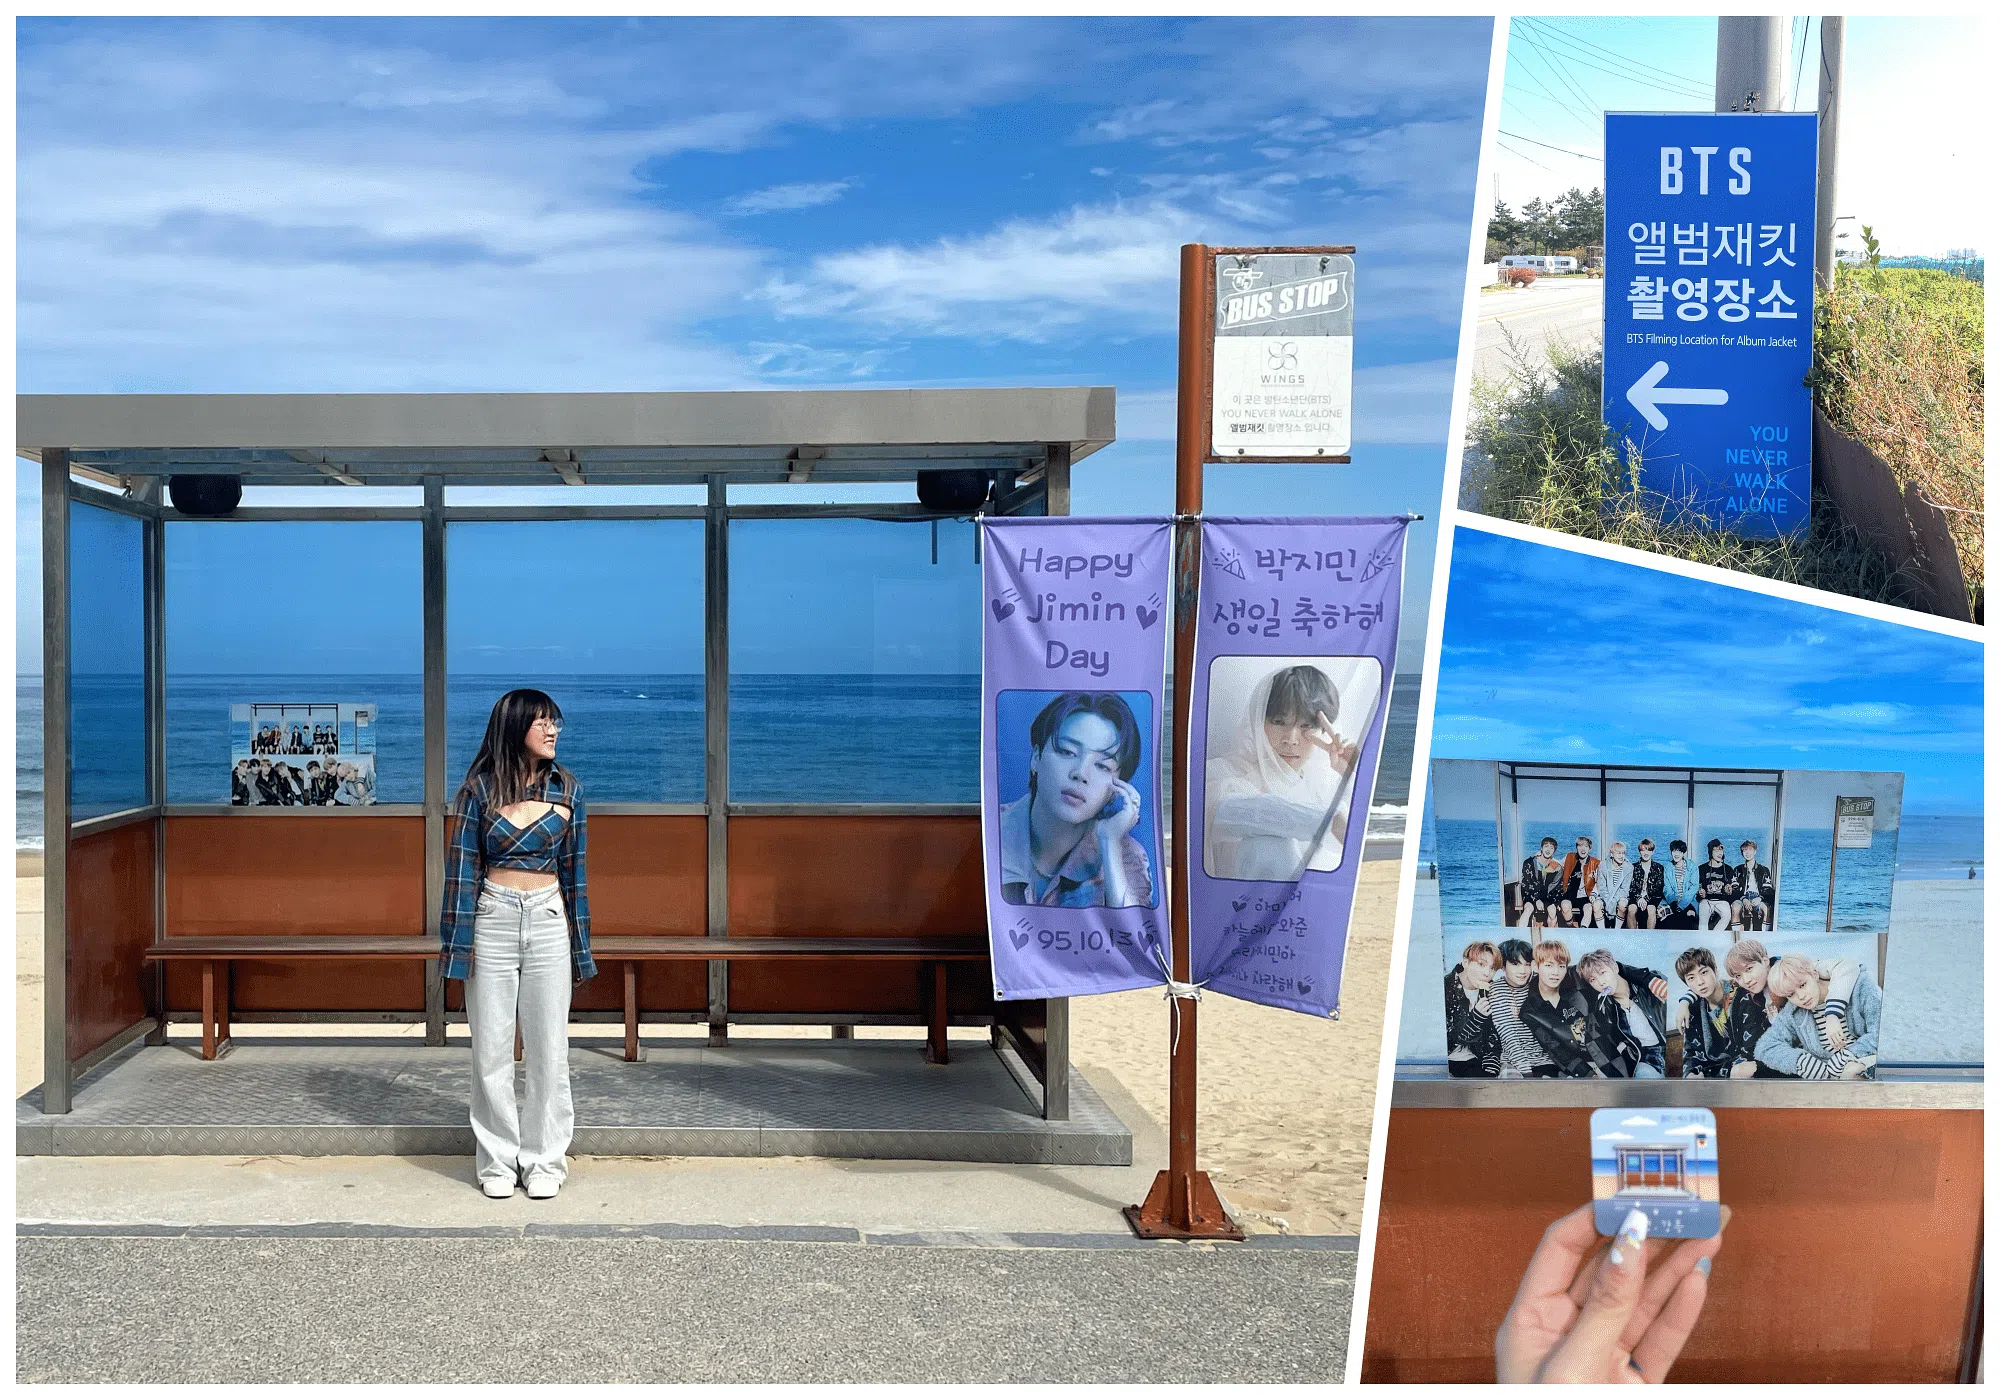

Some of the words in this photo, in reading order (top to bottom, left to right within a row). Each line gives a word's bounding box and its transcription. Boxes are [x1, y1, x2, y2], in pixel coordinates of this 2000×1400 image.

[1660, 146, 1752, 196] BTS
[1627, 221, 1797, 267] 앨범재킷
[1226, 291, 1273, 325] BUS
[1278, 278, 1339, 314] STOP
[1626, 276, 1798, 323] 촬영장소
[1626, 333, 1644, 344] BTS
[1646, 333, 1678, 346] Filming
[1680, 334, 1719, 345] Location
[1720, 334, 1735, 346] for
[1737, 335, 1766, 347] Album
[1768, 336, 1798, 347] Jacket
[1260, 374, 1305, 384] WINGS
[1232, 394, 1241, 405] 이
[1243, 394, 1262, 405] 곳은
[1264, 394, 1332, 405] 방탄소년단(BTS)
[1221, 409, 1242, 418] YOU
[1245, 409, 1276, 418] NEVER
[1279, 409, 1307, 418] WALK
[1309, 408, 1343, 418] ALONE
[1230, 423, 1265, 433] 앨범재킷
[1267, 422, 1302, 433] 촬영장소
[1750, 425, 1789, 442] YOU
[1726, 448, 1788, 466] NEVER
[1734, 472, 1788, 489] WALK
[1725, 496, 1788, 514] ALONE
[1018, 547, 1134, 580] Happy
[1255, 547, 1357, 582] 박지민
[1027, 591, 1126, 624] Jimin
[1212, 597, 1281, 638] 생일
[1290, 597, 1385, 637] 축하해
[1045, 640, 1110, 676] Day
[1037, 929, 1133, 955] 95.10.13
